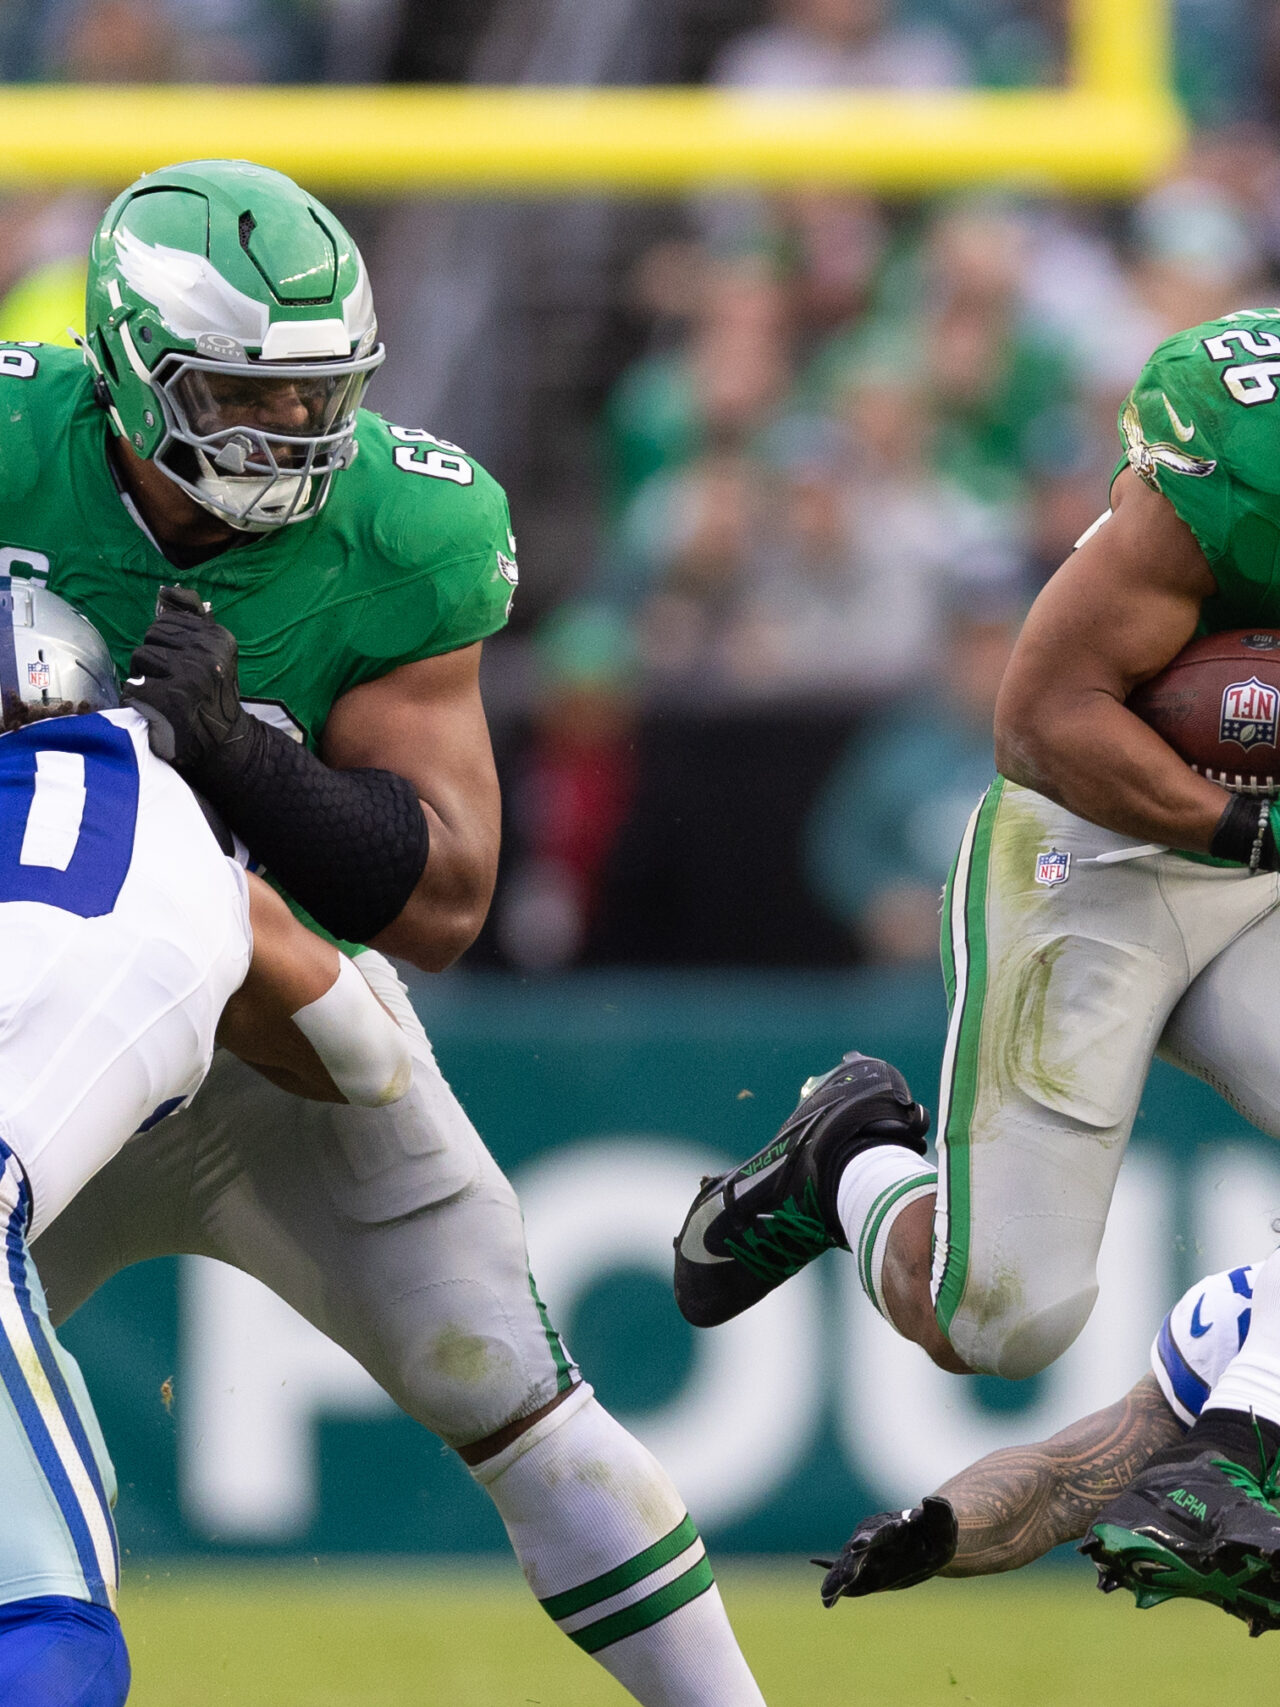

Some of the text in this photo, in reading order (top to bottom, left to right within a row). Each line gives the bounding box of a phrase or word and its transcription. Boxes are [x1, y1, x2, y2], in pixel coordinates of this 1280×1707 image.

[387, 424, 475, 487] 68
[30, 672, 49, 688] NFL
[1229, 687, 1274, 721] NFL
[1040, 864, 1063, 880] NFL
[740, 1136, 790, 1177] ALPHA
[1166, 1488, 1208, 1522] ALPHA
